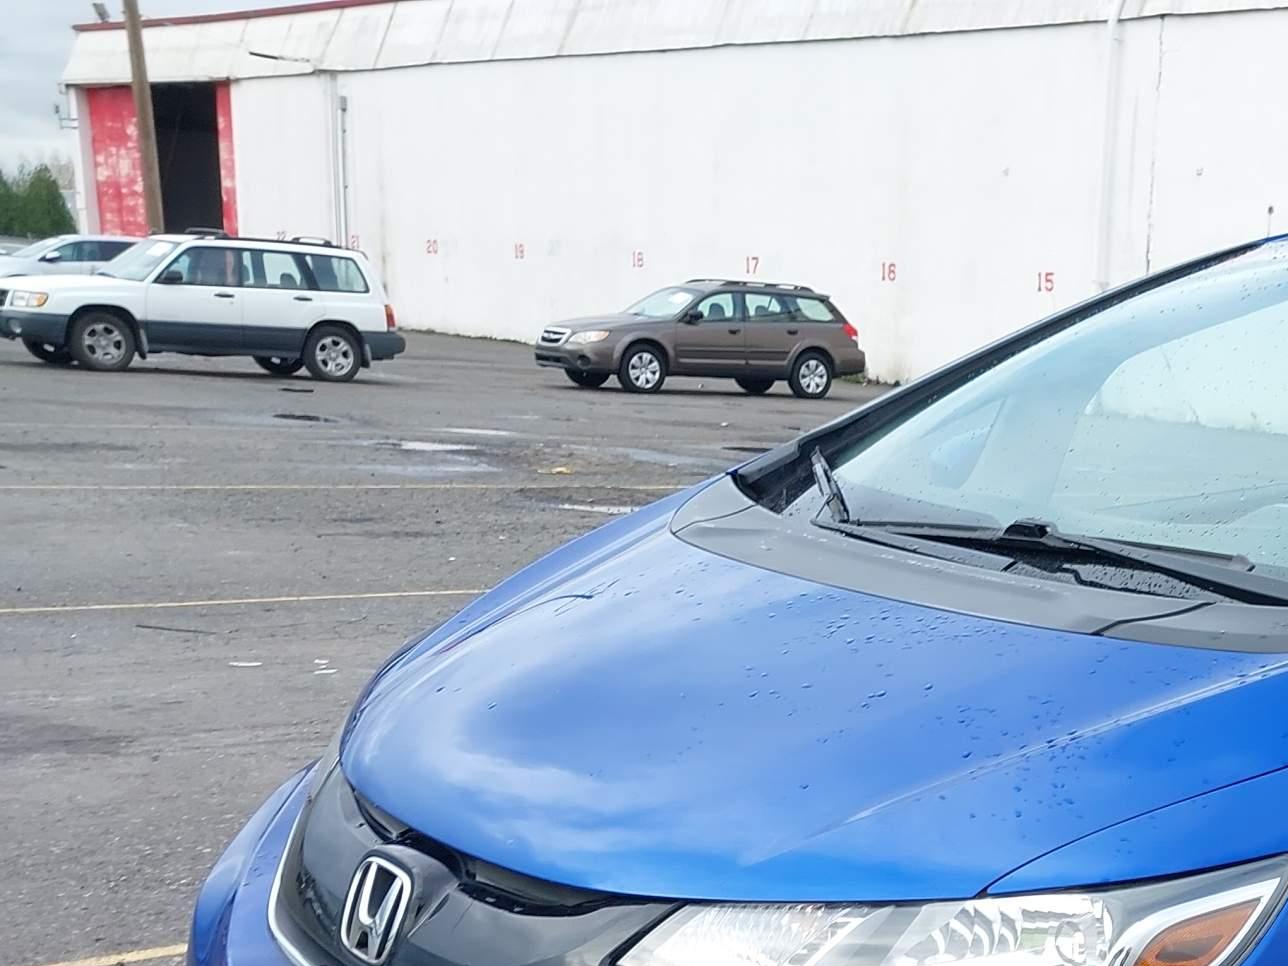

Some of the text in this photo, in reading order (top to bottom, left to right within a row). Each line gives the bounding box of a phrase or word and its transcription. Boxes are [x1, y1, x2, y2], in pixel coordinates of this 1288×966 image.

[426, 239, 438, 255] 20
[514, 243, 525, 259] 19
[632, 251, 644, 267] 18
[746, 256, 759, 274] 17
[881, 262, 896, 281] 16
[1037, 271, 1055, 292] 15
